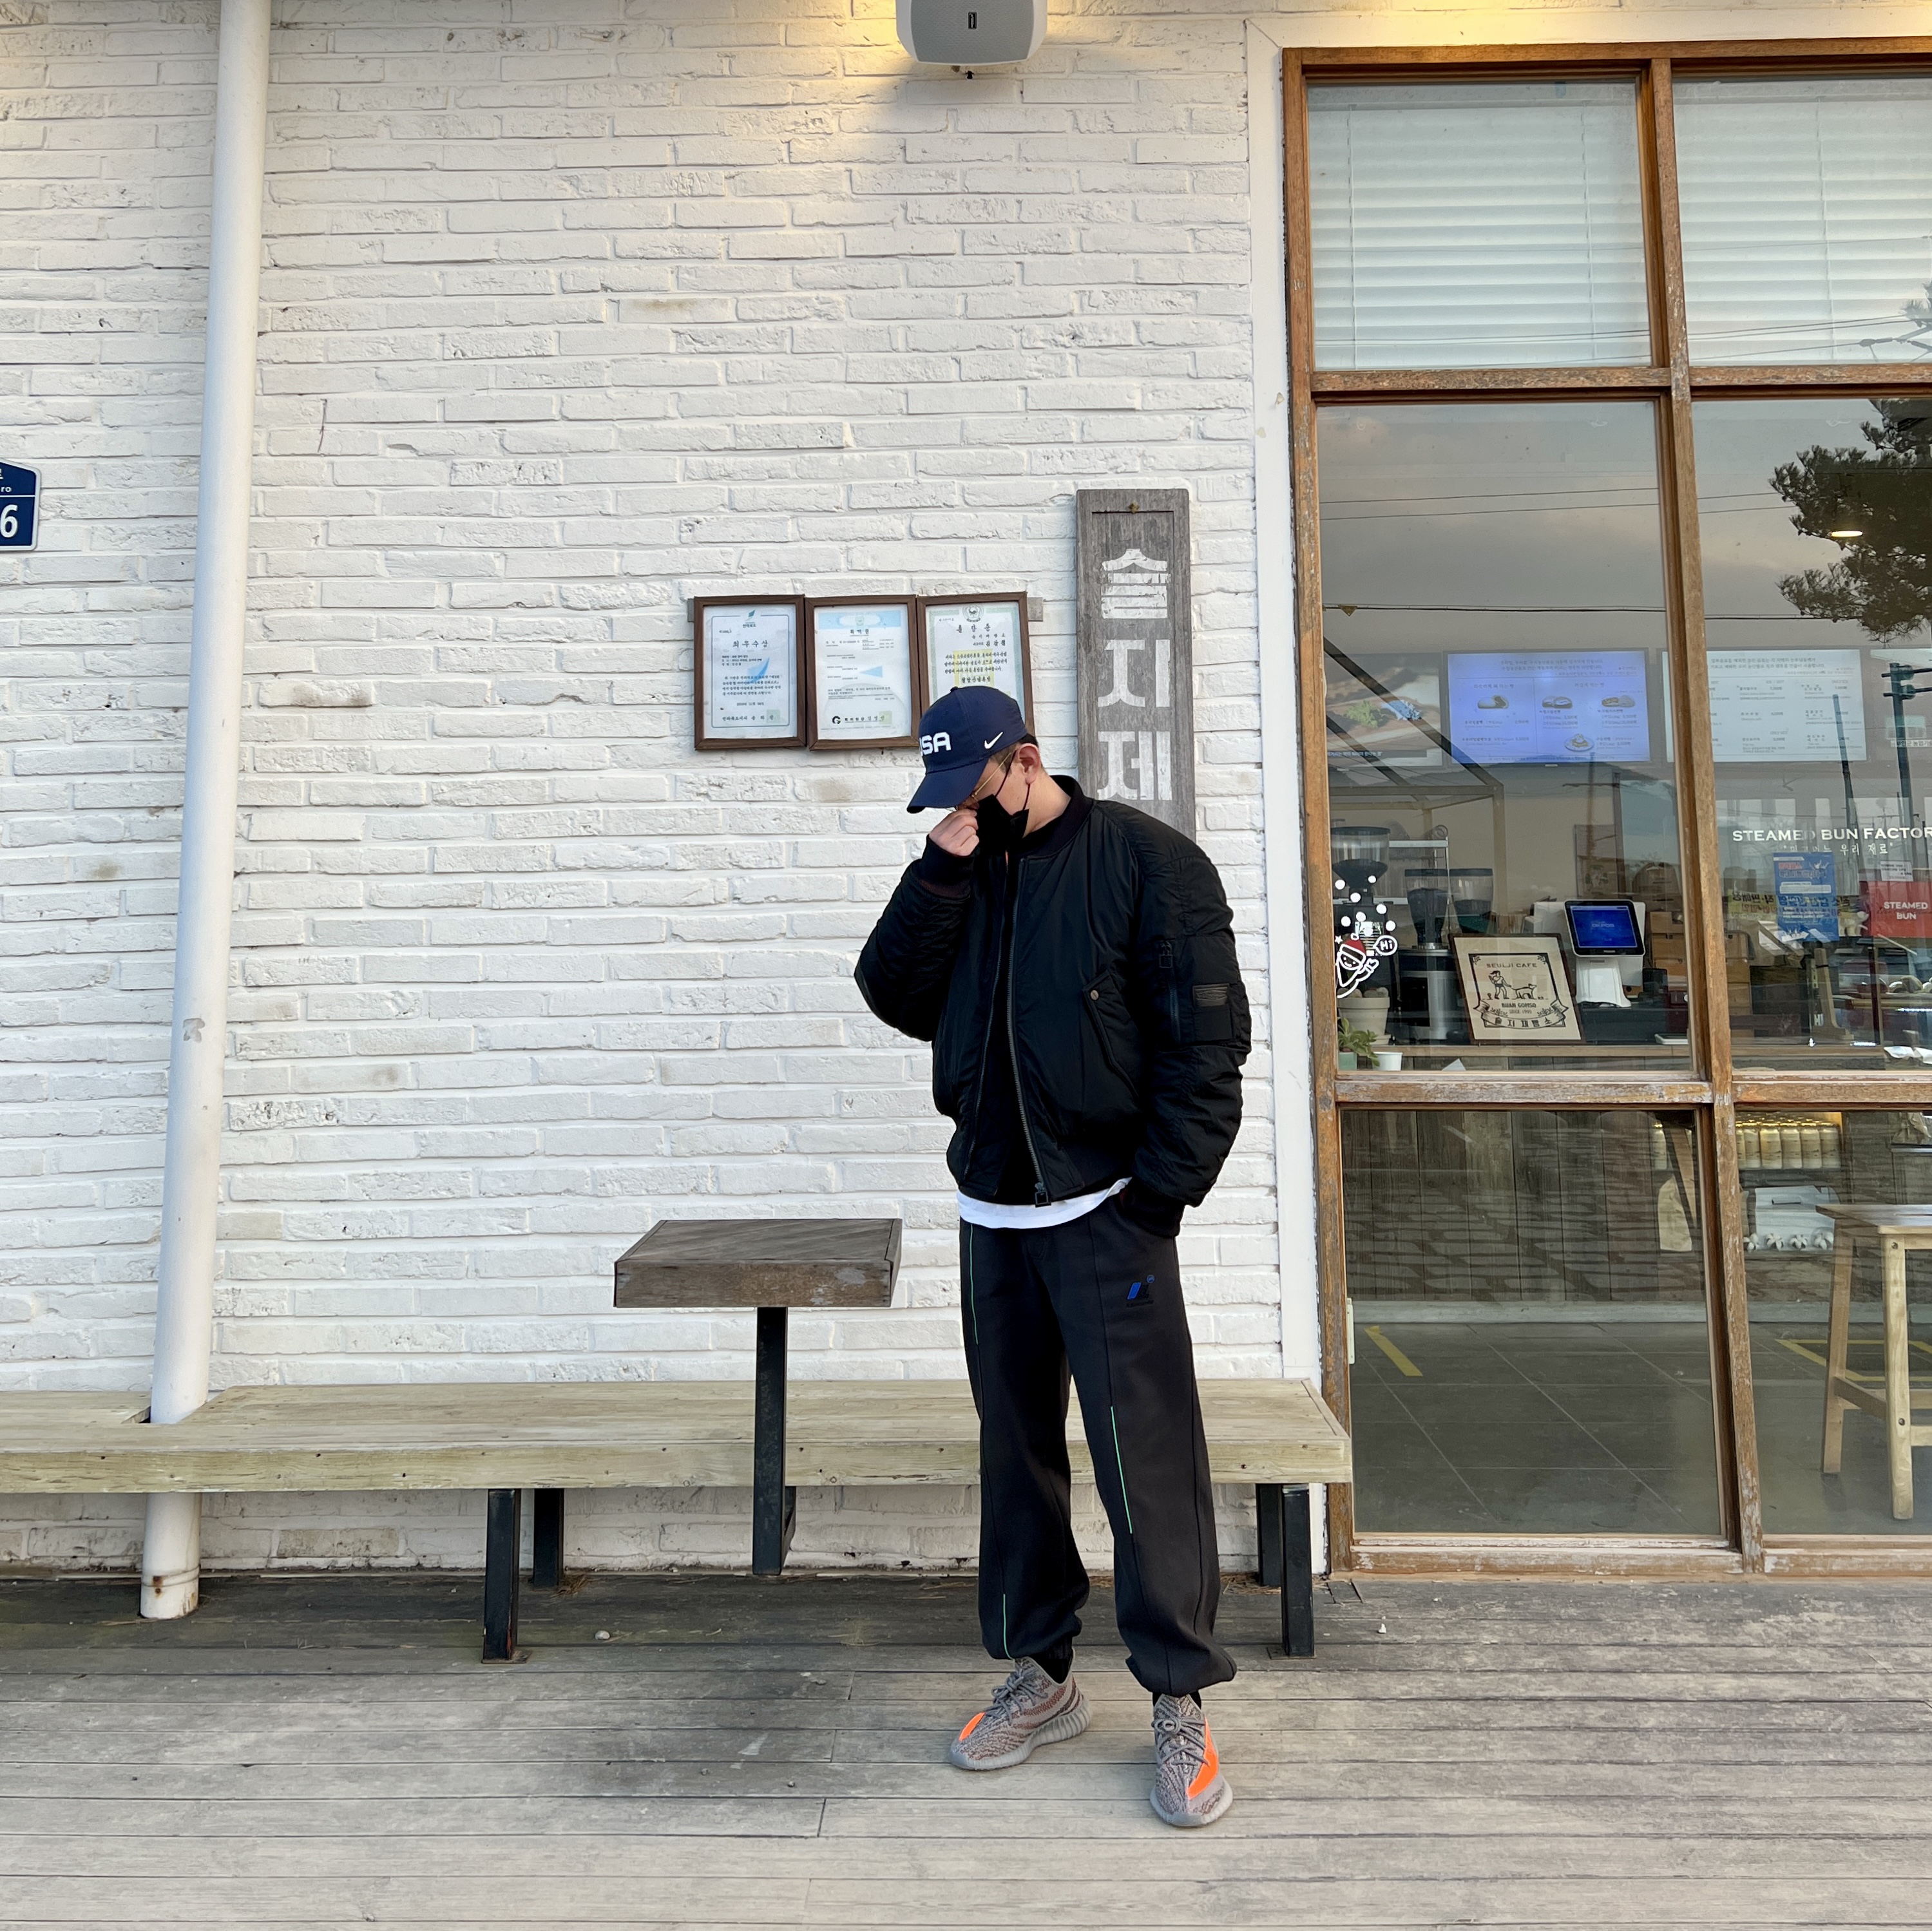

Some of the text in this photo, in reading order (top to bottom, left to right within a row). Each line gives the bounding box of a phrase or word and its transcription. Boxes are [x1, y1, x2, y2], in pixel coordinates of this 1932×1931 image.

[0, 504, 18, 538] 6
[1097, 547, 1172, 801] 슬지제
[1732, 829, 1815, 841] STEAMED
[1821, 828, 1859, 840] BUN
[1840, 842, 1860, 855] 우리
[1884, 902, 1928, 910] STEAMED
[1380, 940, 1393, 951] Hi
